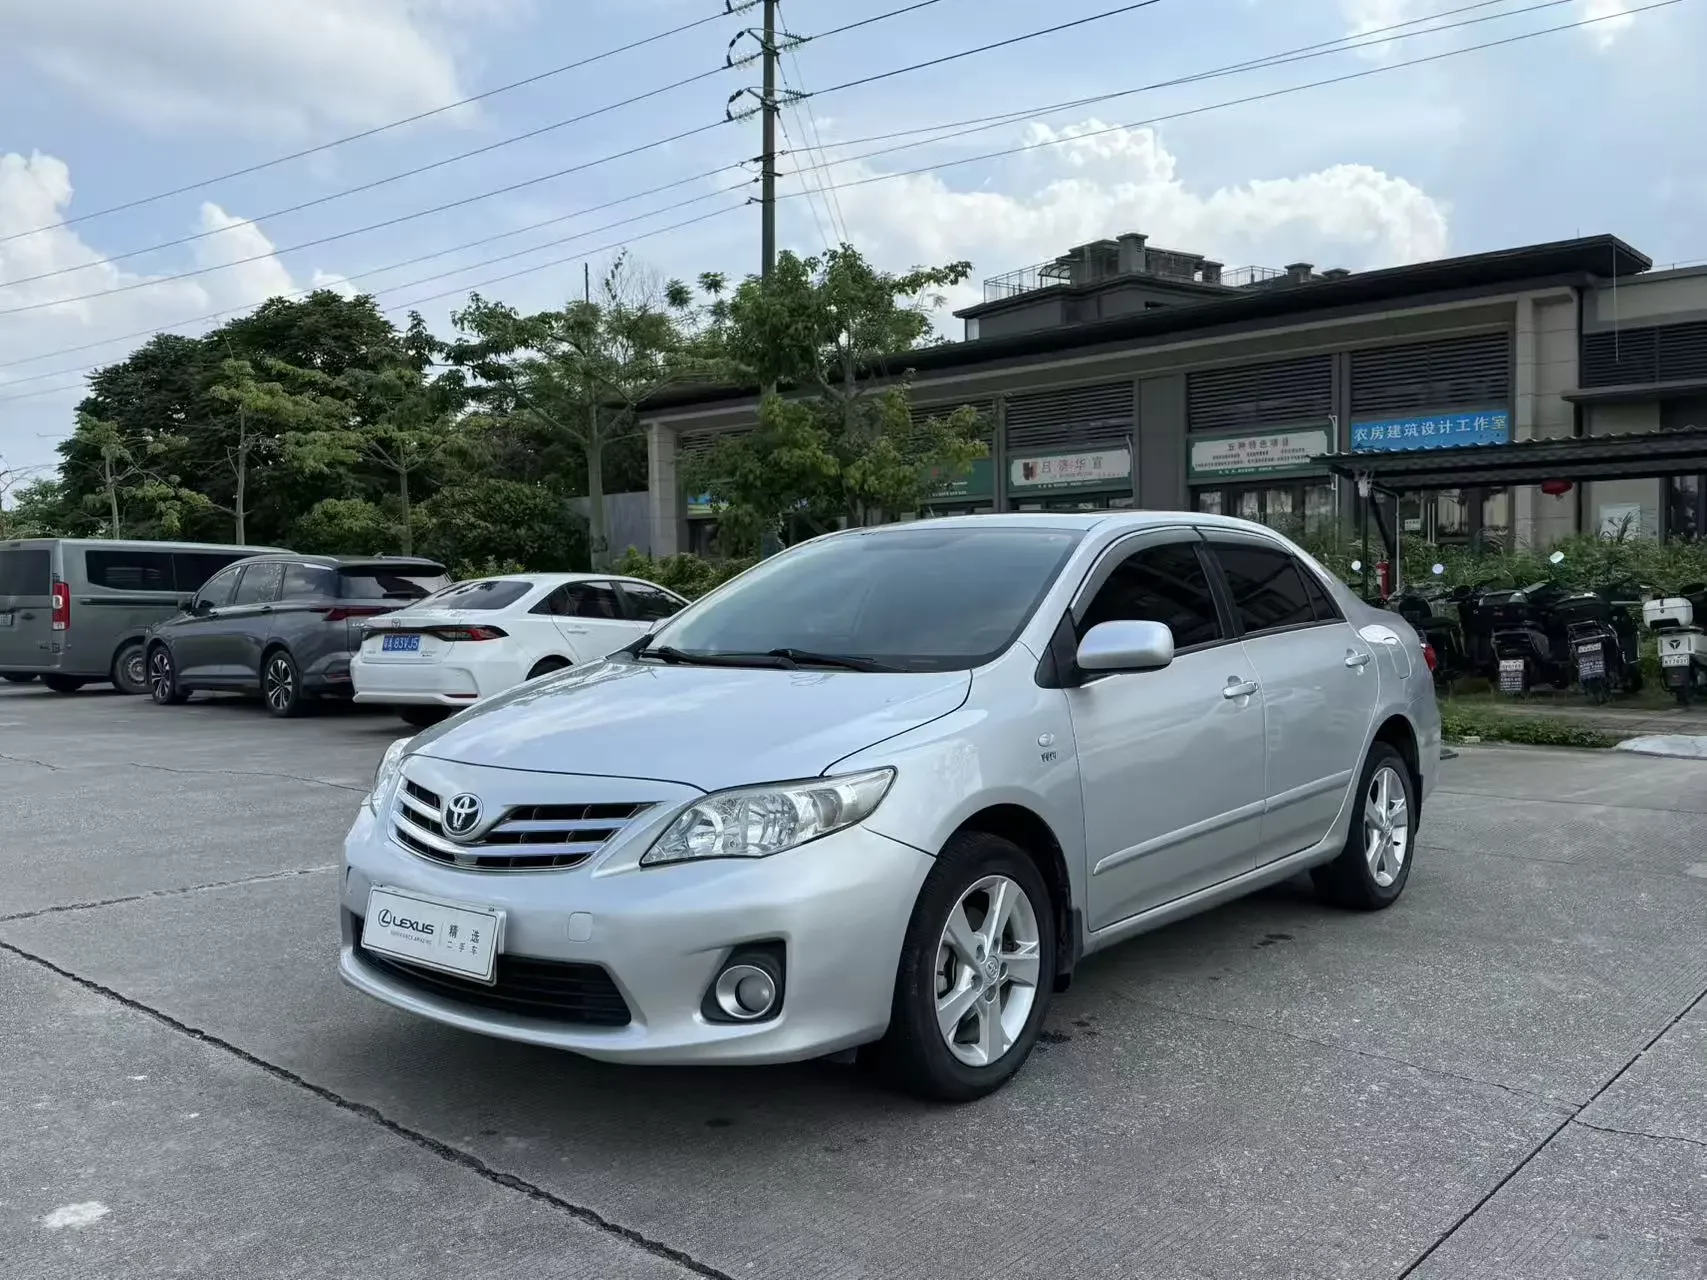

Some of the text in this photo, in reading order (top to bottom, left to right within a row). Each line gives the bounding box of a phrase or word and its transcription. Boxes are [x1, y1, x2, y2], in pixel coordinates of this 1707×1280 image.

[1354, 415, 1507, 442] 农房建筑设计工作室
[392, 915, 435, 935] LEXUS
